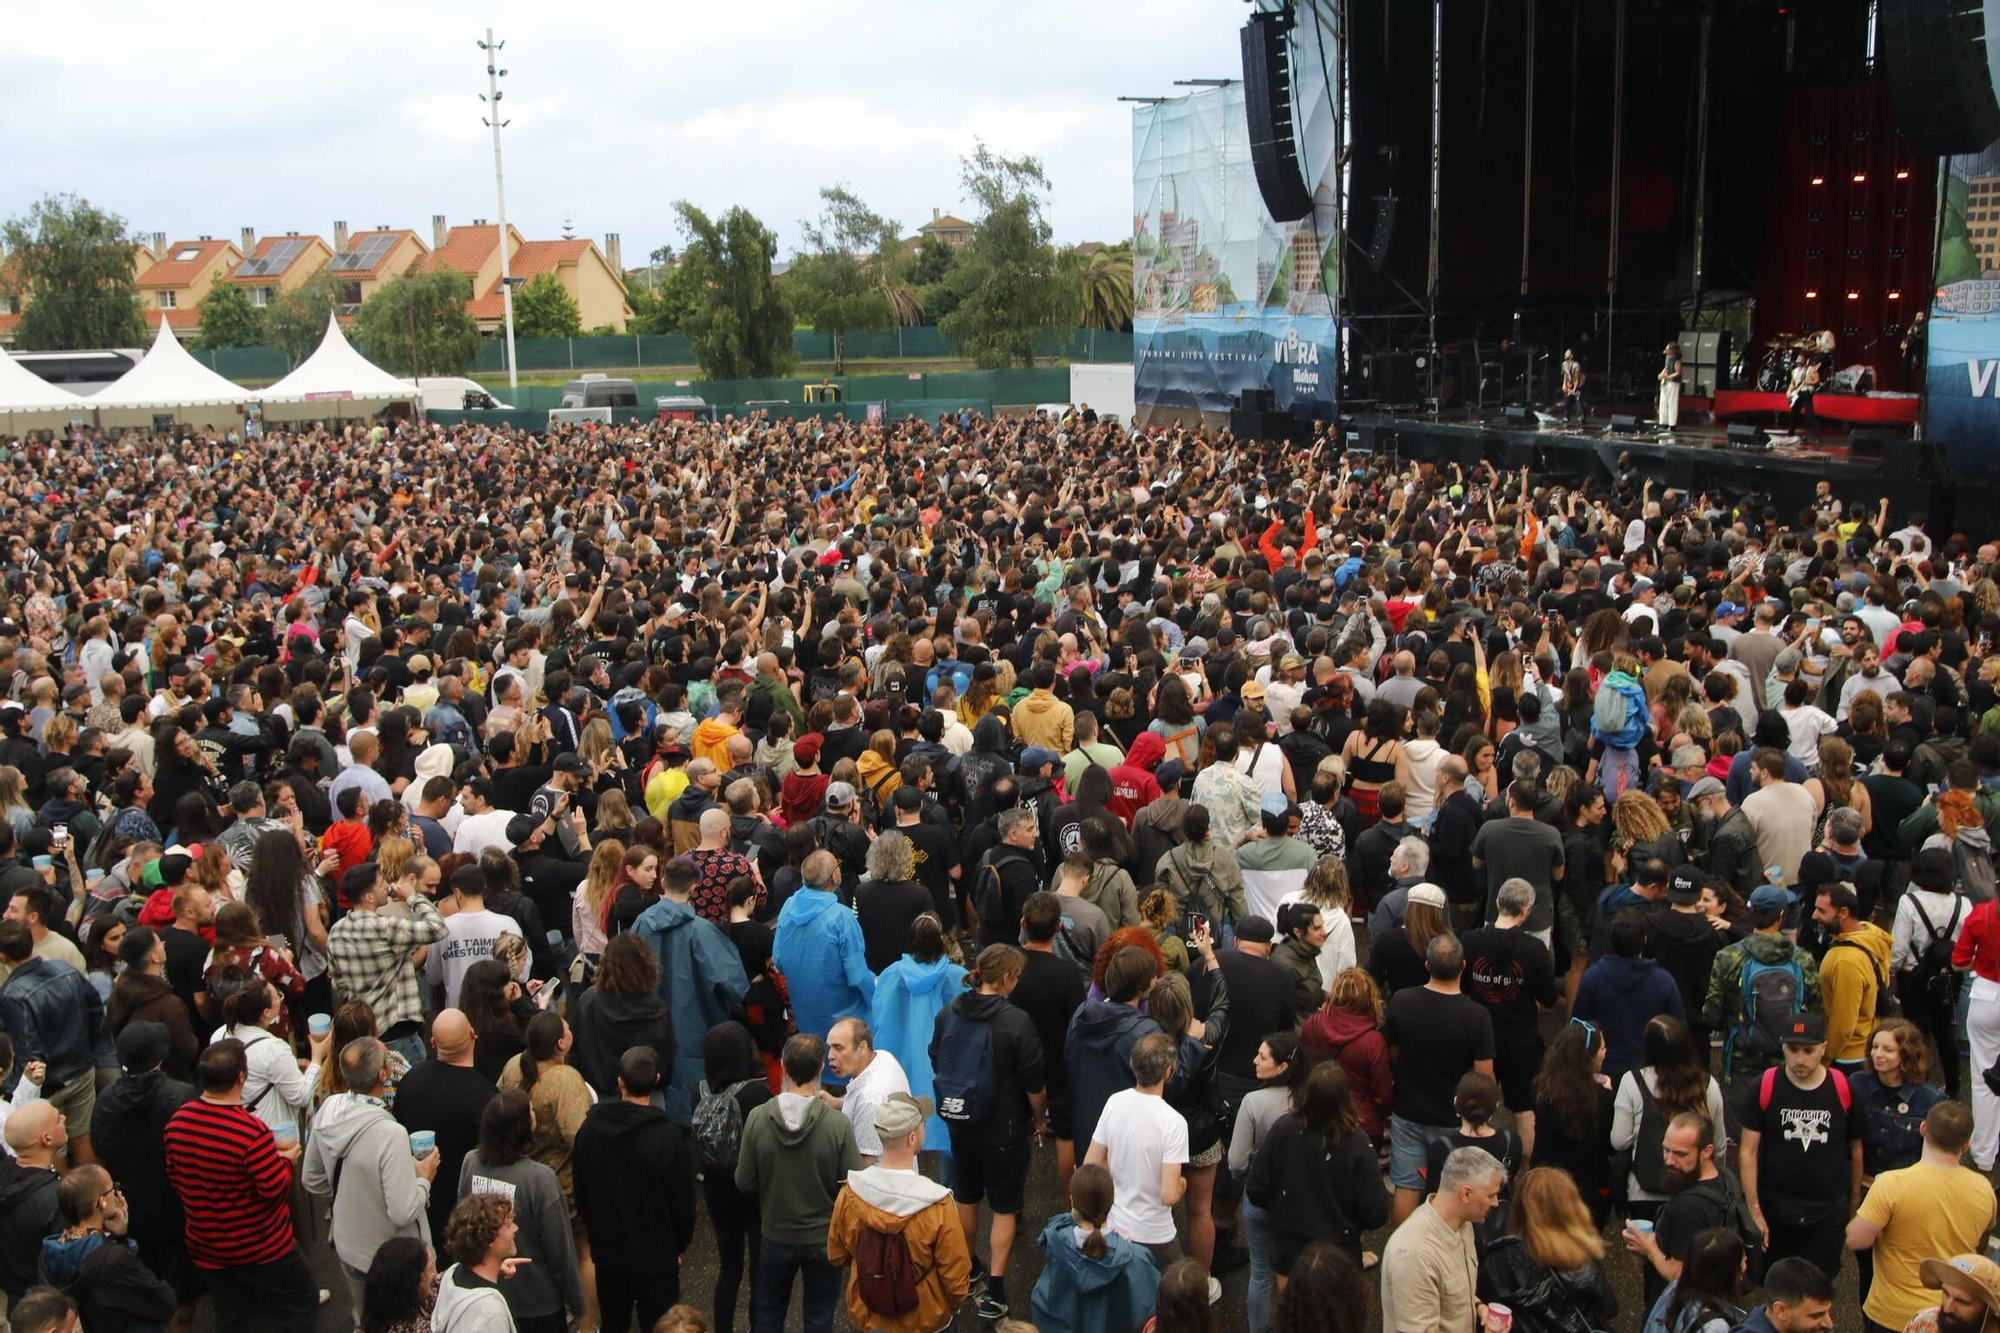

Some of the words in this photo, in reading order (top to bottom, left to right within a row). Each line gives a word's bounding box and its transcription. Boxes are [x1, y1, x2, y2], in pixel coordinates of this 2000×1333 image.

[1275, 327, 1319, 364] VIBRA
[1139, 350, 1175, 359] TSUNAMI
[1208, 352, 1257, 362] FESTIVAL
[448, 940, 459, 950] JE
[1780, 1108, 1832, 1128] THRASHER
